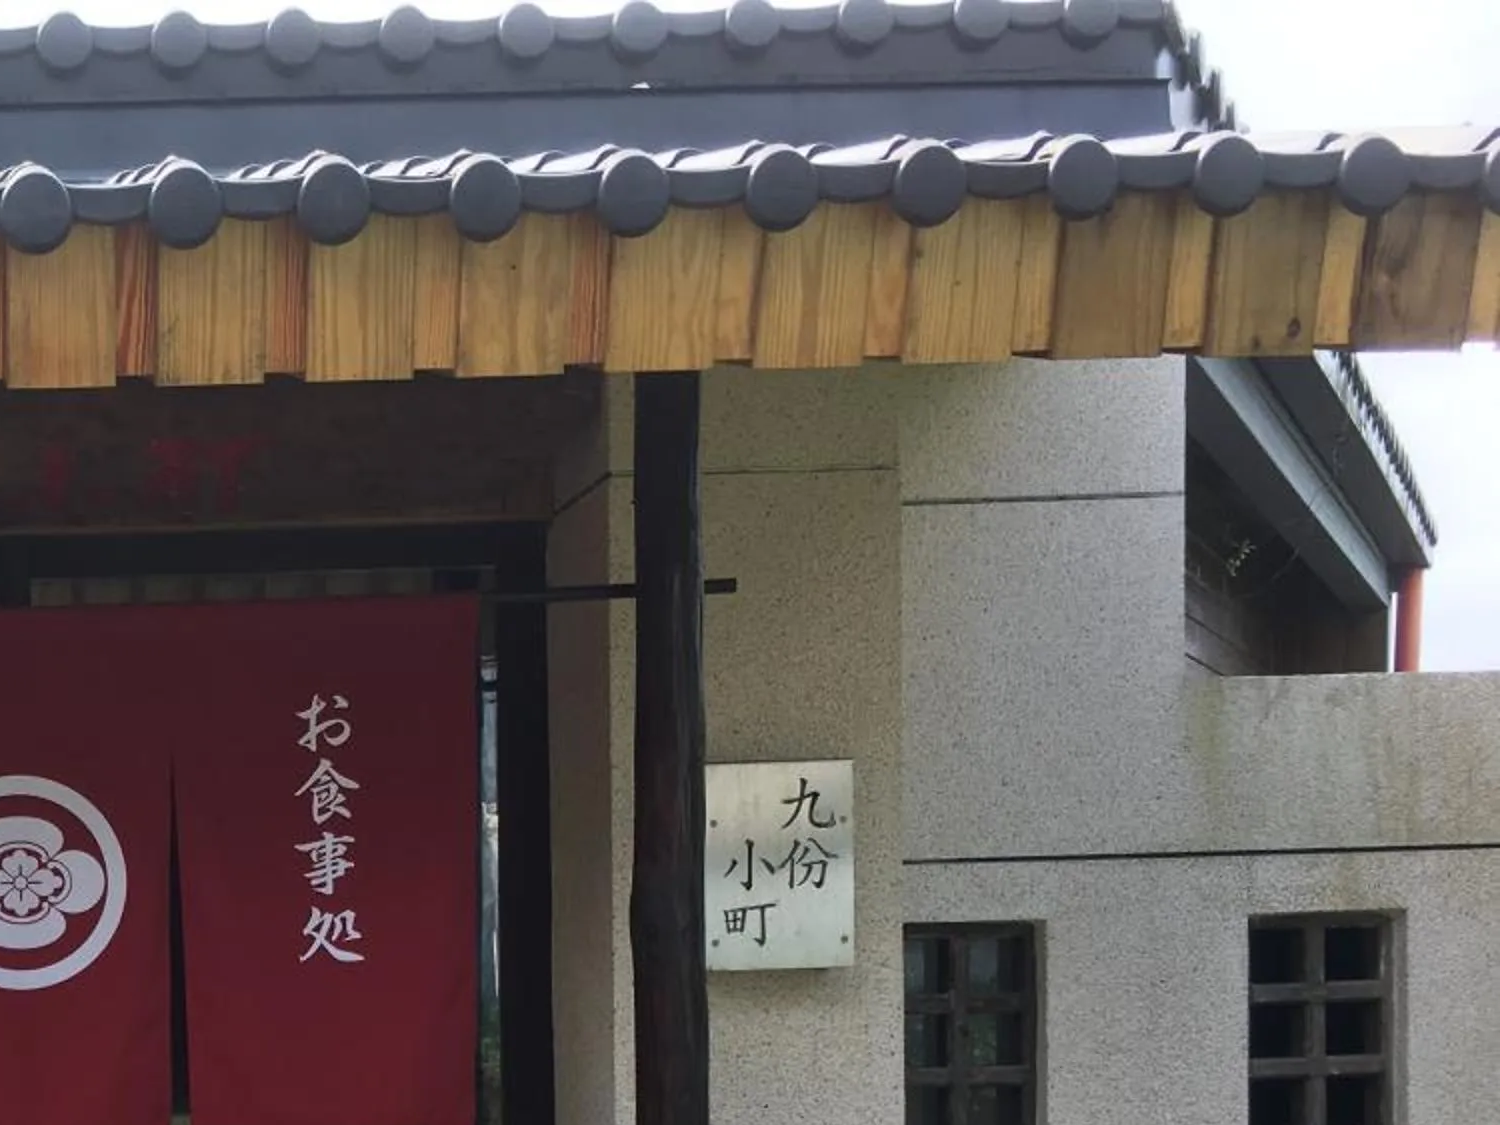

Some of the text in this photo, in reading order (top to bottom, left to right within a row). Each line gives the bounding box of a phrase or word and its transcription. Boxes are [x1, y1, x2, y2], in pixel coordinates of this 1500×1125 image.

[294, 693, 365, 963] お食事処
[777, 777, 839, 889] 九份
[723, 839, 777, 947] 小町
